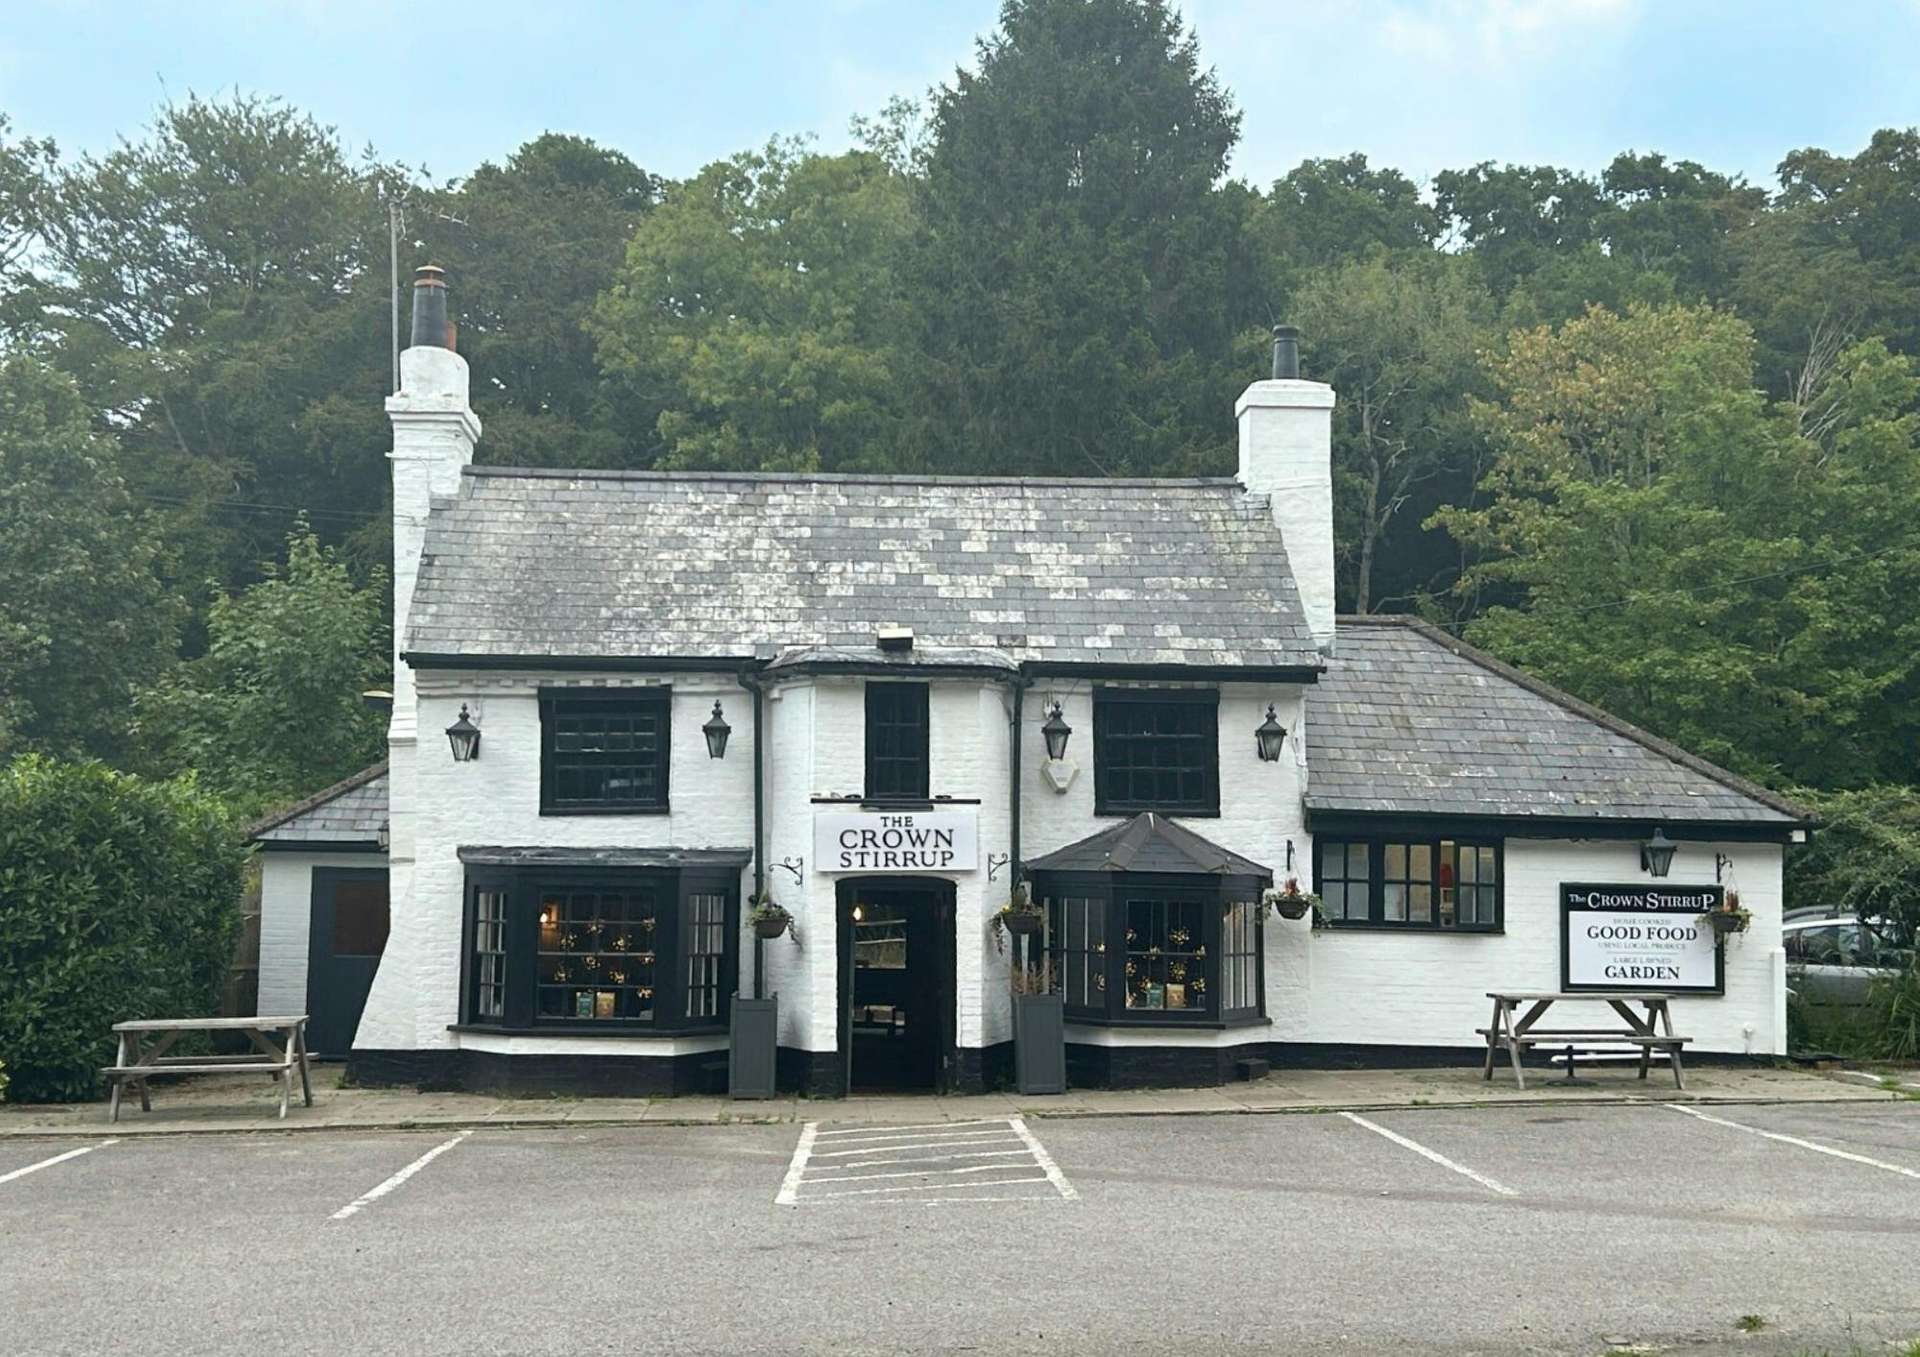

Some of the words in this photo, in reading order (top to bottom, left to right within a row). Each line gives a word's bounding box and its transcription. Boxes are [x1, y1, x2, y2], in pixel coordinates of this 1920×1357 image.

[880, 816, 914, 828] THE
[839, 829, 954, 849] CROWN
[840, 850, 954, 868] STIRRUP
[1568, 893, 1586, 903] The
[1587, 892, 1644, 909] CROWN
[1646, 892, 1715, 910] STIRRUP
[1587, 925, 1641, 940] GOOD
[1647, 926, 1698, 941] FOOD
[1604, 965, 1681, 980] GARDEN
